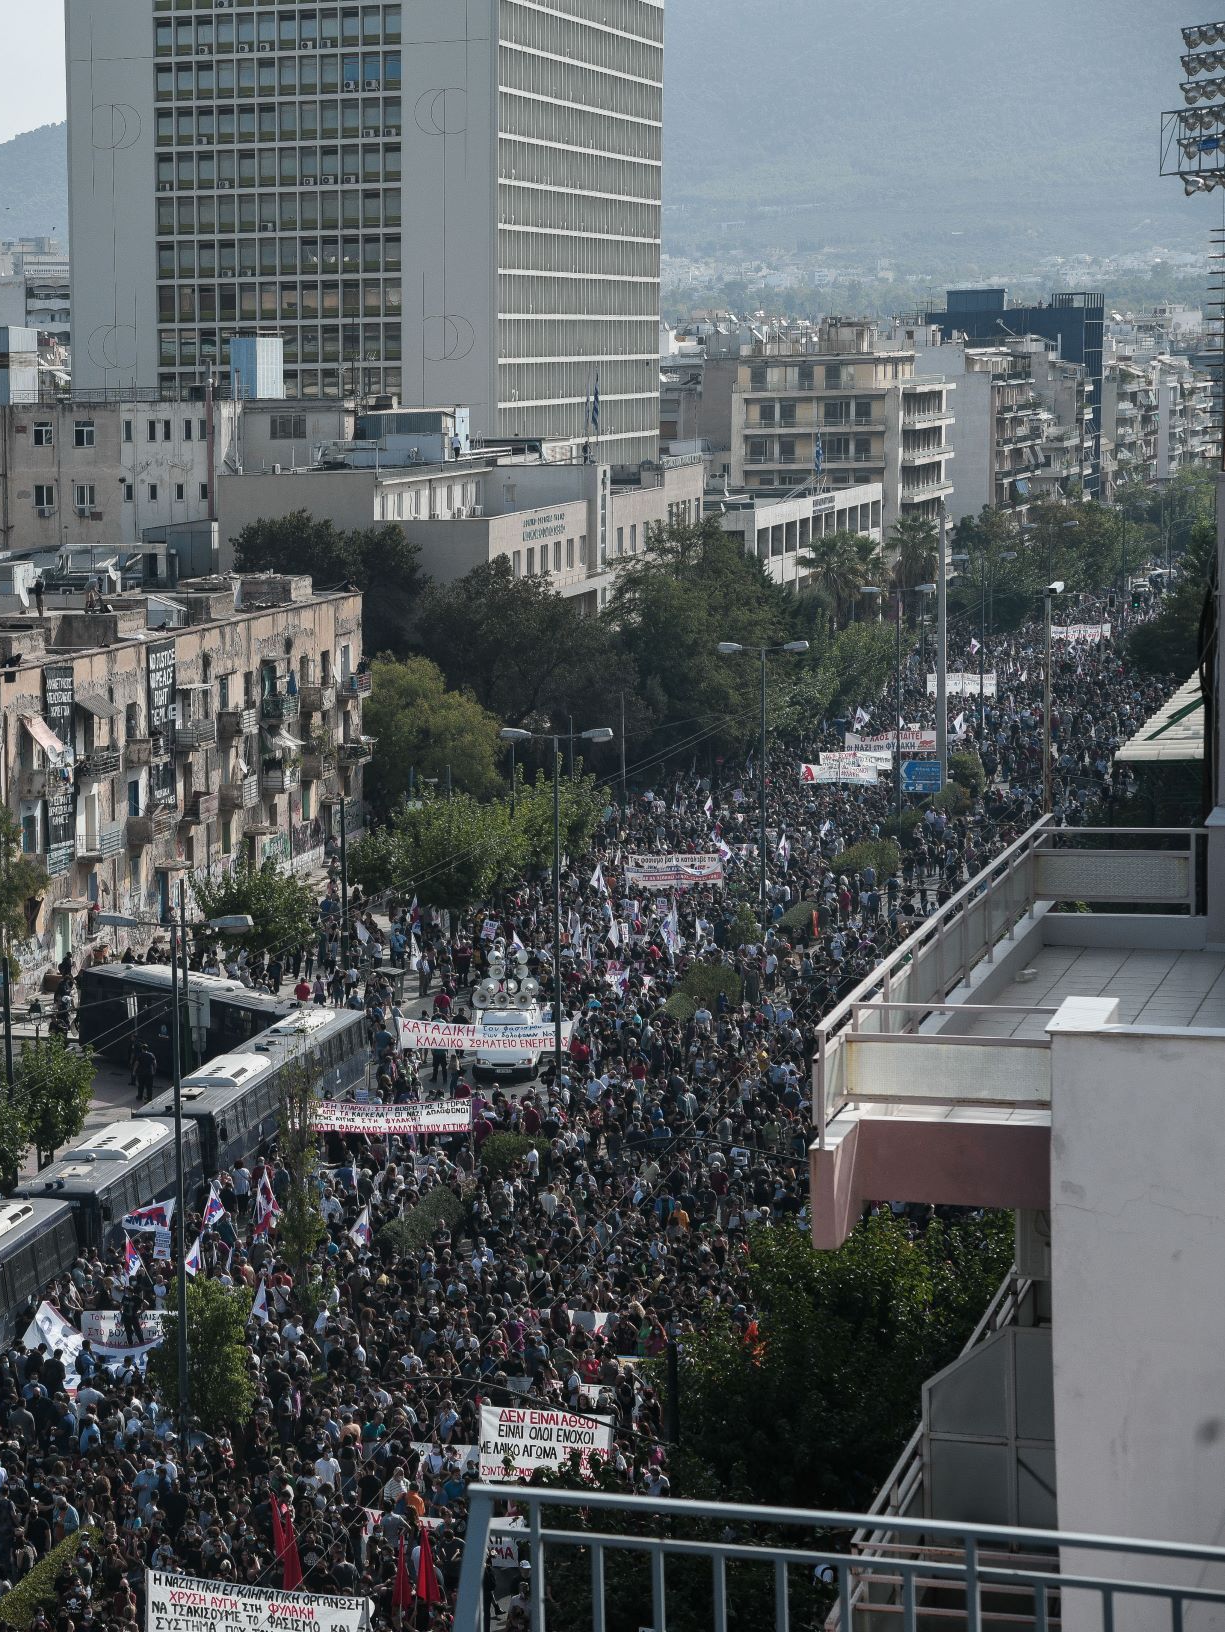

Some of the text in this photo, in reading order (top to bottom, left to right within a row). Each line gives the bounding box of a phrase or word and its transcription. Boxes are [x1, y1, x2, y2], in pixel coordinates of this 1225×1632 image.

[402, 1020, 476, 1037] ΚΑΤΑΔΙΚΗ
[416, 1036, 464, 1048] ΚΛΑΔΙΚΟ
[469, 1039, 517, 1049] ΣΩΜΑΤΕΙΟ
[420, 1103, 435, 1111] ΤΗΣ
[498, 1408, 527, 1424] ΔΕΝ
[529, 1411, 559, 1426] ΕΙΝΑΙ
[497, 1423, 595, 1446] ΕΙΝΑΙ ΟΛΟΙ ΕΝΟΧΟΙ
[522, 1444, 558, 1460] ΑΓΩΝΑ
[153, 1573, 365, 1611] Η ΝΑΖΙΣΤΙΚΗ ΕΓΚΛΗΜΑΤΙΚΗ ΟΡΓΑΝΩΣΗ
[168, 1590, 314, 1620] ΧΡΥΣΗ ΑΥΓΗ ΣΤΗ ΦΥΛΑΚΗ
[151, 1600, 321, 1632] ΝΑ ΤΣΑΚΙΣΟΥΜΕ ΤΟ ΦΑΣΙΣΜΟ
[155, 1616, 217, 1632] ΣΥΣΤΗΜΑ
